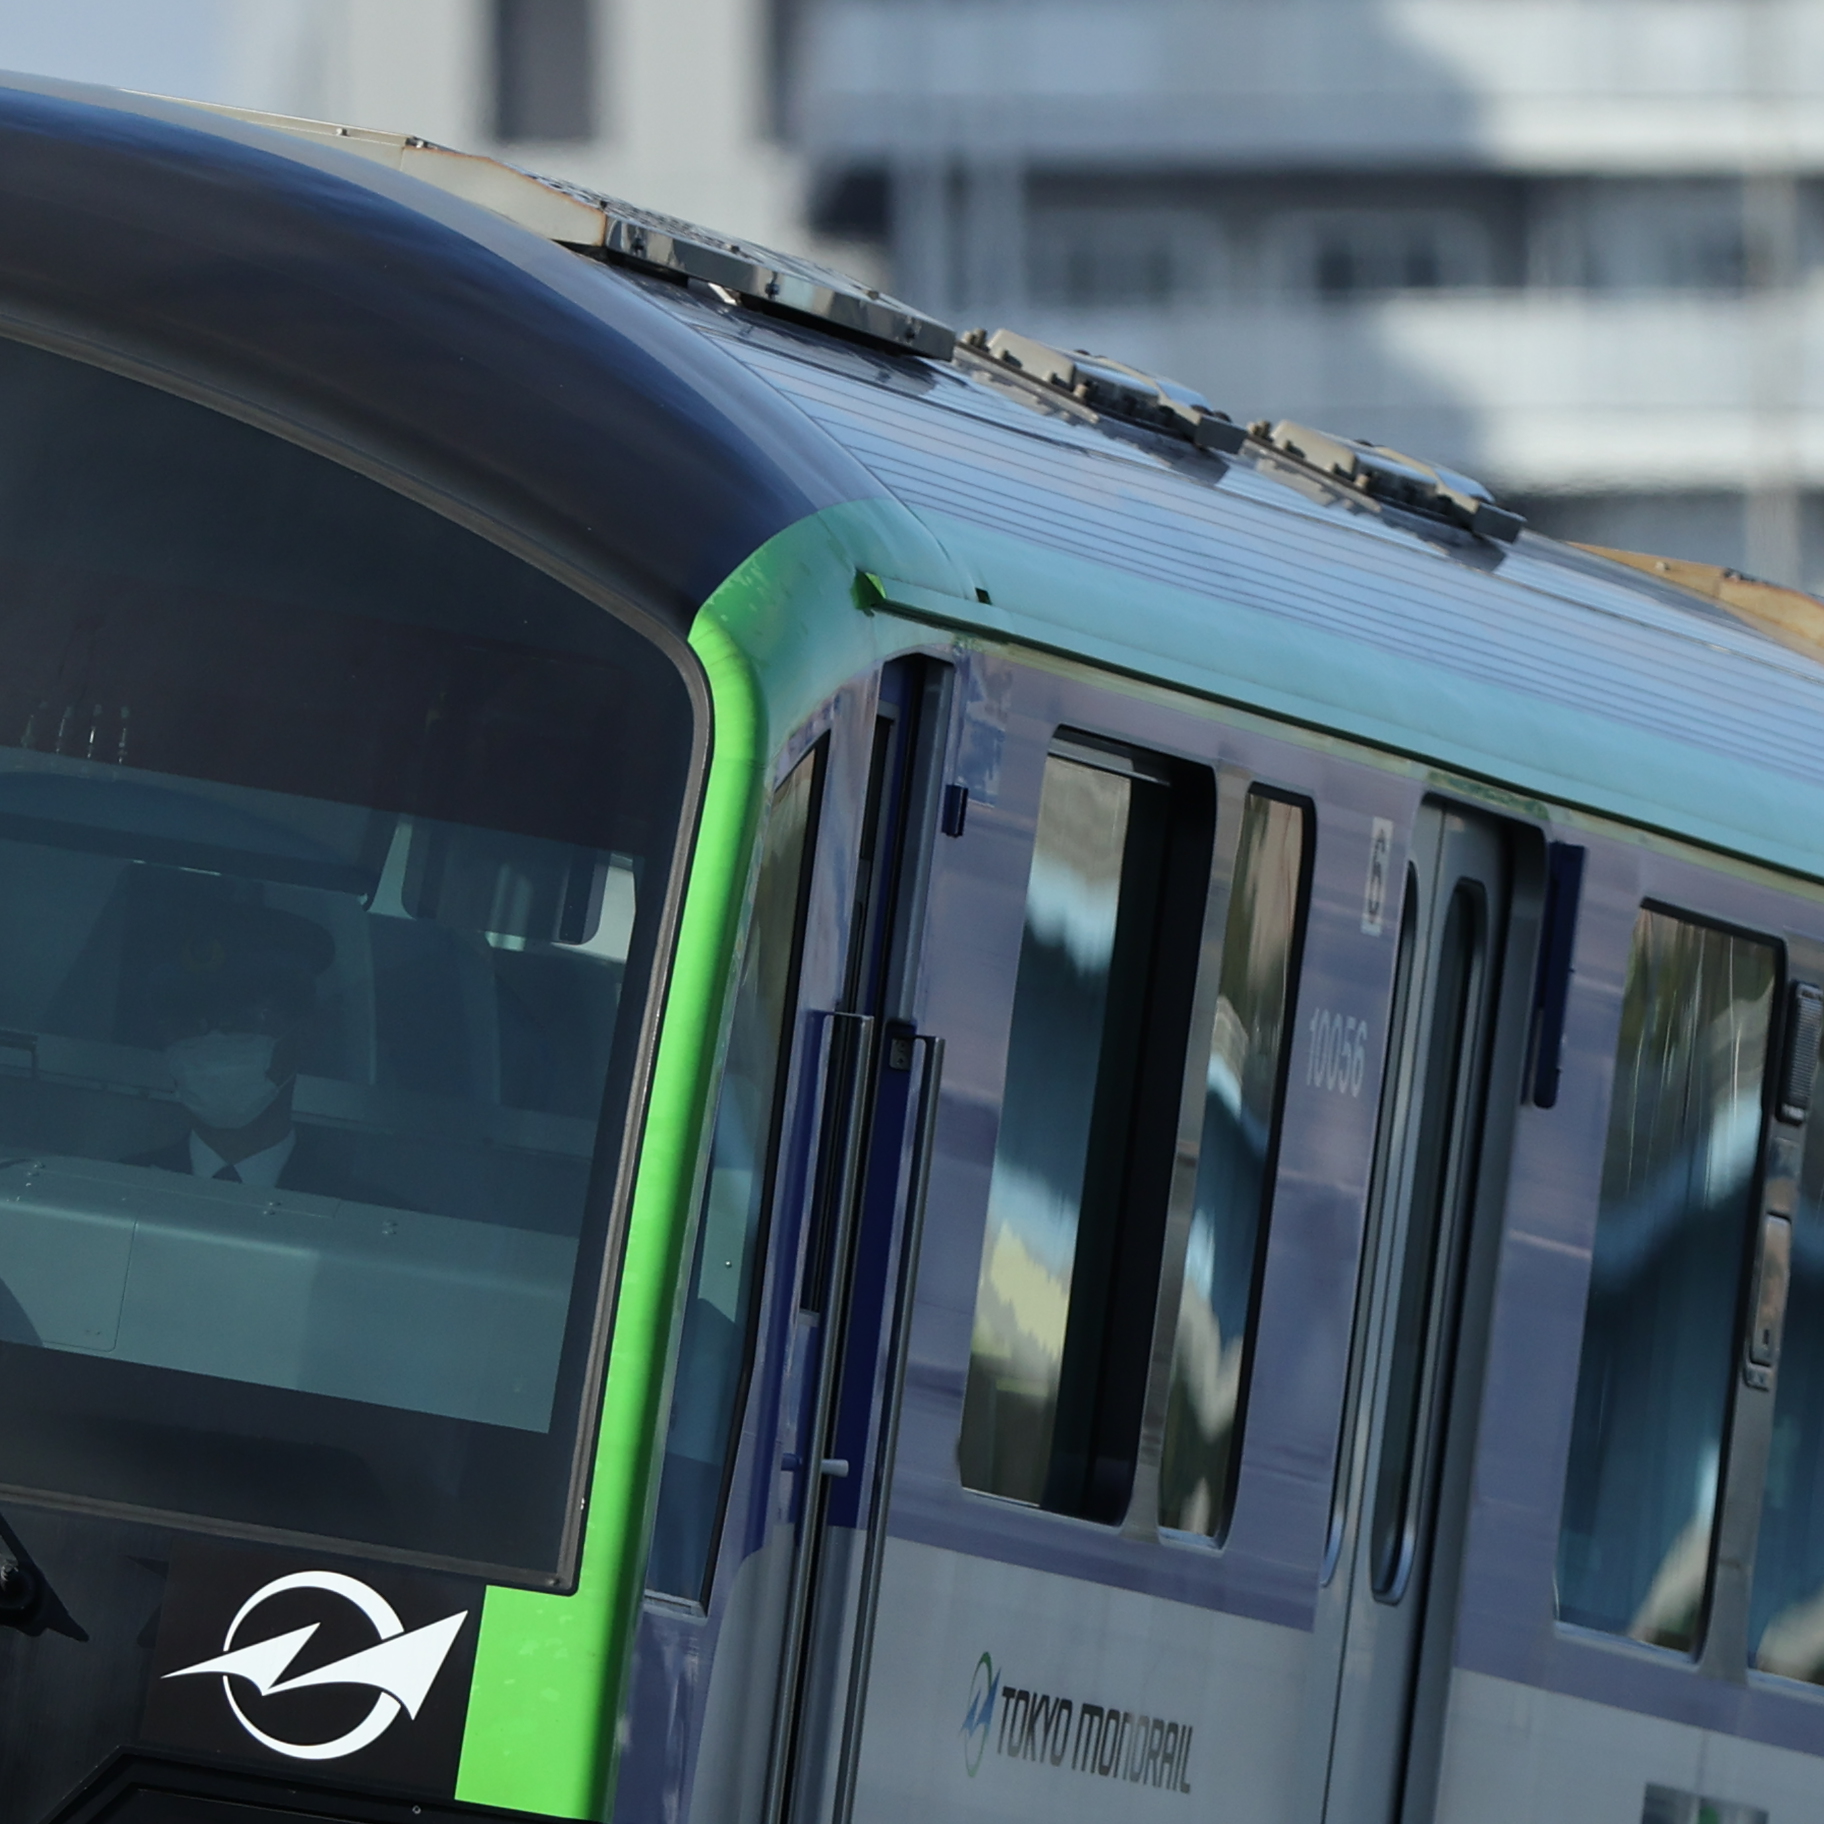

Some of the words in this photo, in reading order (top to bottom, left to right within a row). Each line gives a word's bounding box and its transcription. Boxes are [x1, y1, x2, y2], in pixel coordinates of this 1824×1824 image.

[1306, 1007, 1368, 1098] 10056
[998, 1685, 1074, 1768] TOKYO
[1072, 1703, 1193, 1795] MONORAIL
